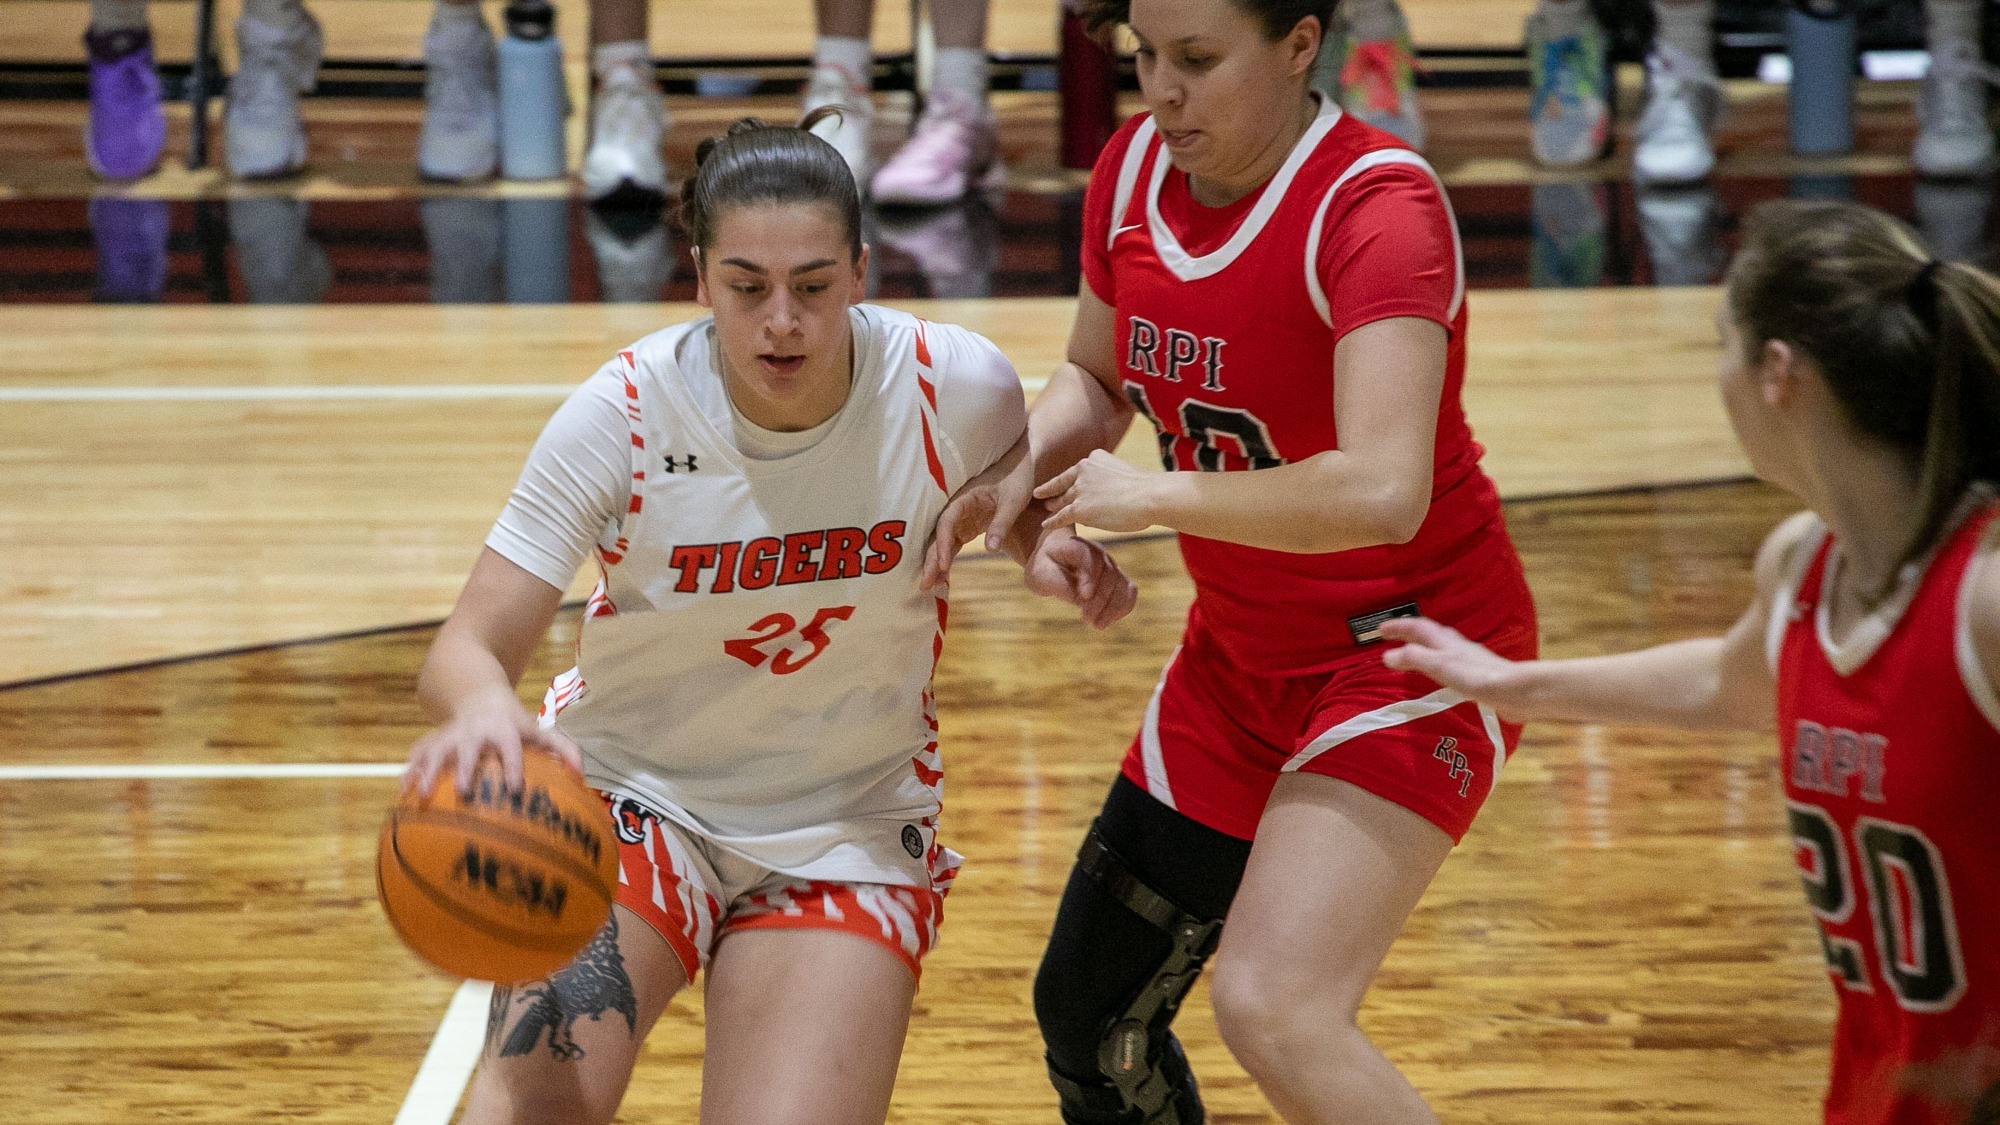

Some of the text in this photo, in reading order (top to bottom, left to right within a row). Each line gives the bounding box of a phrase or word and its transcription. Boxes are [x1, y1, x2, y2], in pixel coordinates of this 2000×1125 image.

[1126, 315, 1228, 392] RPI
[668, 520, 907, 594] TIGERS
[723, 605, 857, 675] 25
[1432, 735, 1474, 798] RPI
[1793, 718, 1889, 804] RPI
[1786, 799, 1969, 1013] 20
